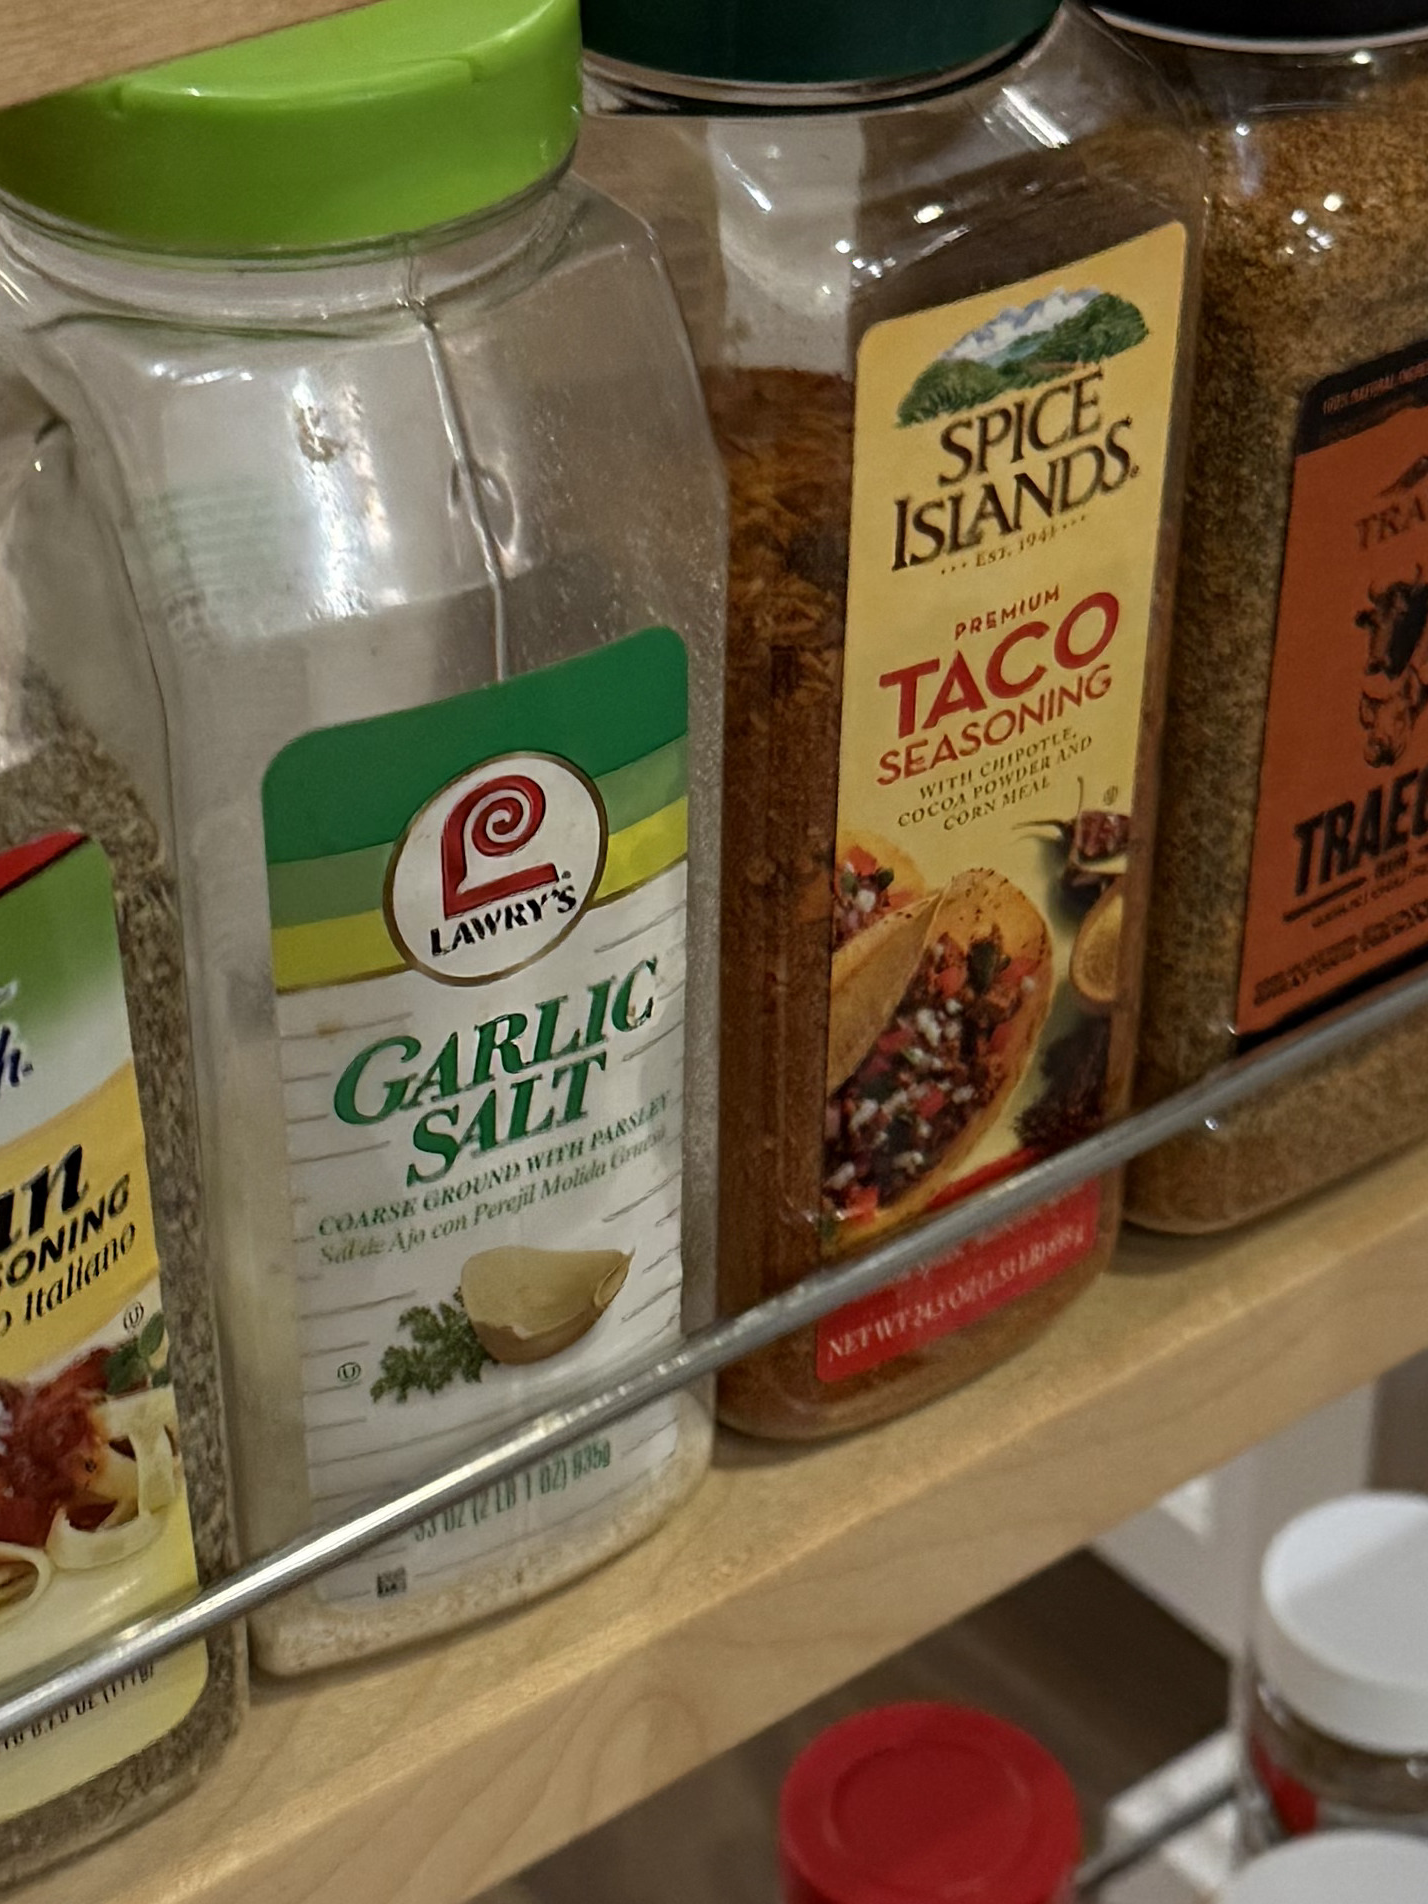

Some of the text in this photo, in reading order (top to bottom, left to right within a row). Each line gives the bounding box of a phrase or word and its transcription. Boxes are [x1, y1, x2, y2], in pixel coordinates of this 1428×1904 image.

[938, 366, 1104, 490] SPICE
[891, 416, 1134, 572] ISLANDS
[878, 591, 1120, 739] TACO
[953, 584, 1061, 641] PREMIUM
[876, 663, 1112, 786] SEASONING
[897, 734, 1093, 828] COCOA POWDER AND
[918, 727, 1078, 800] WITH CHIPOTLE,
[943, 776, 1051, 832] CORN MEAL
[429, 883, 578, 958] LAWRY'S
[333, 957, 658, 1126] GARLIC
[318, 1093, 668, 1237] COARSE GROUND WITH PARSLEY
[405, 1050, 608, 1189] SALT
[387, 1228, 427, 1255] Ajo
[431, 1215, 467, 1240] con
[472, 1183, 537, 1228] Perejil
[540, 1157, 607, 1201] Molida
[22, 1221, 138, 1328] Italiano
